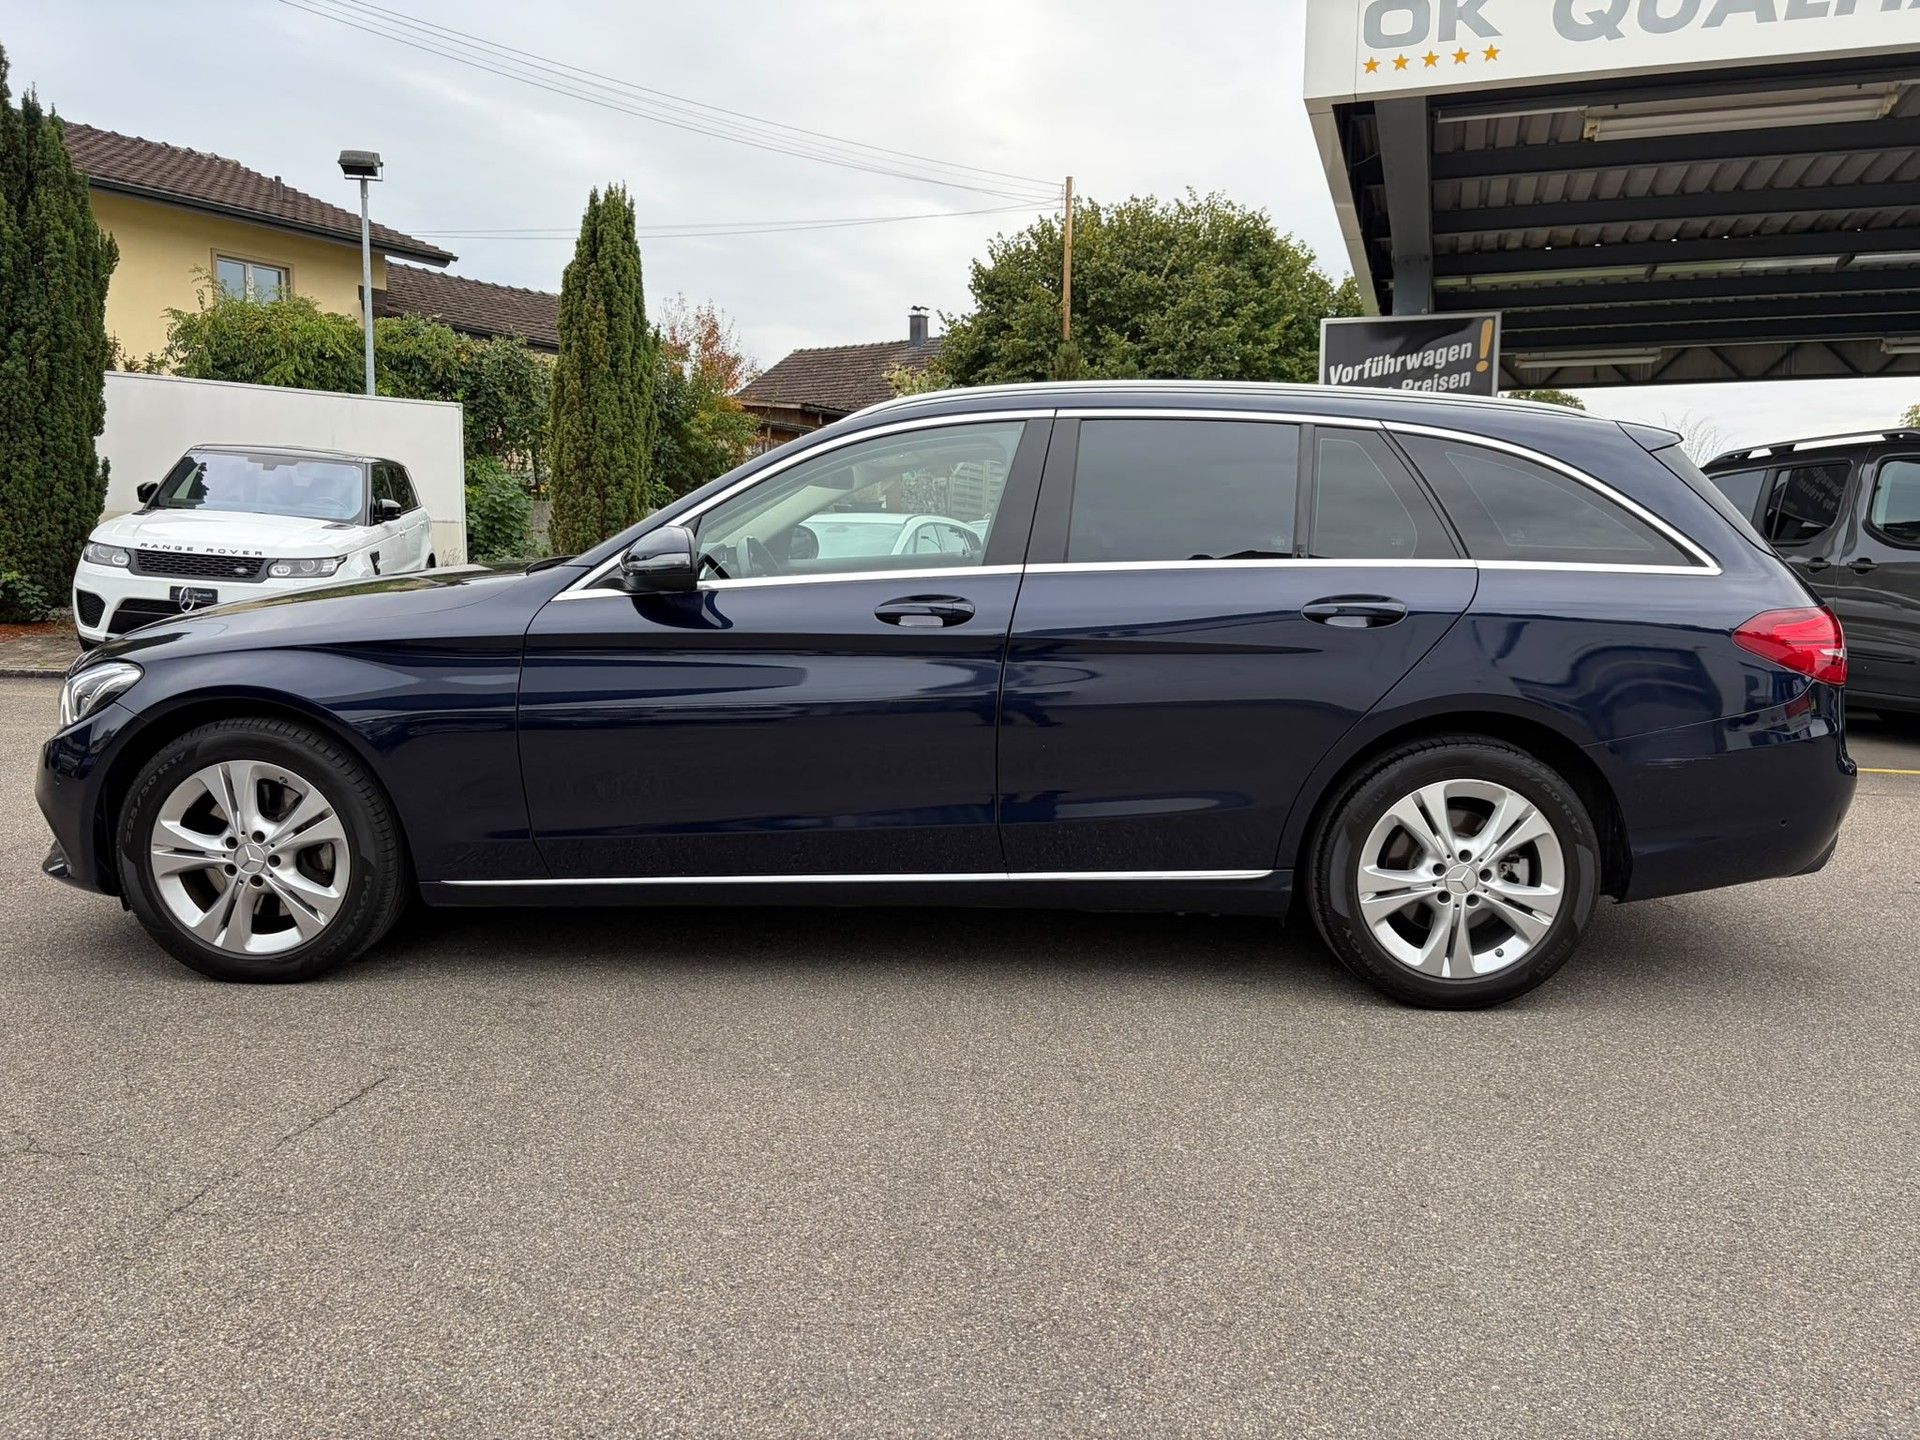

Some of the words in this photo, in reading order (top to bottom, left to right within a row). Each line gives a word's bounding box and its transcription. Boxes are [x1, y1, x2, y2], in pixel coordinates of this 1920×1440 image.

[1364, 0, 1503, 49] OK
[1329, 342, 1473, 386] Vorführwagen
[1402, 371, 1472, 392] Preisen
[140, 542, 194, 552] RANGE
[206, 547, 263, 556] ROVER
